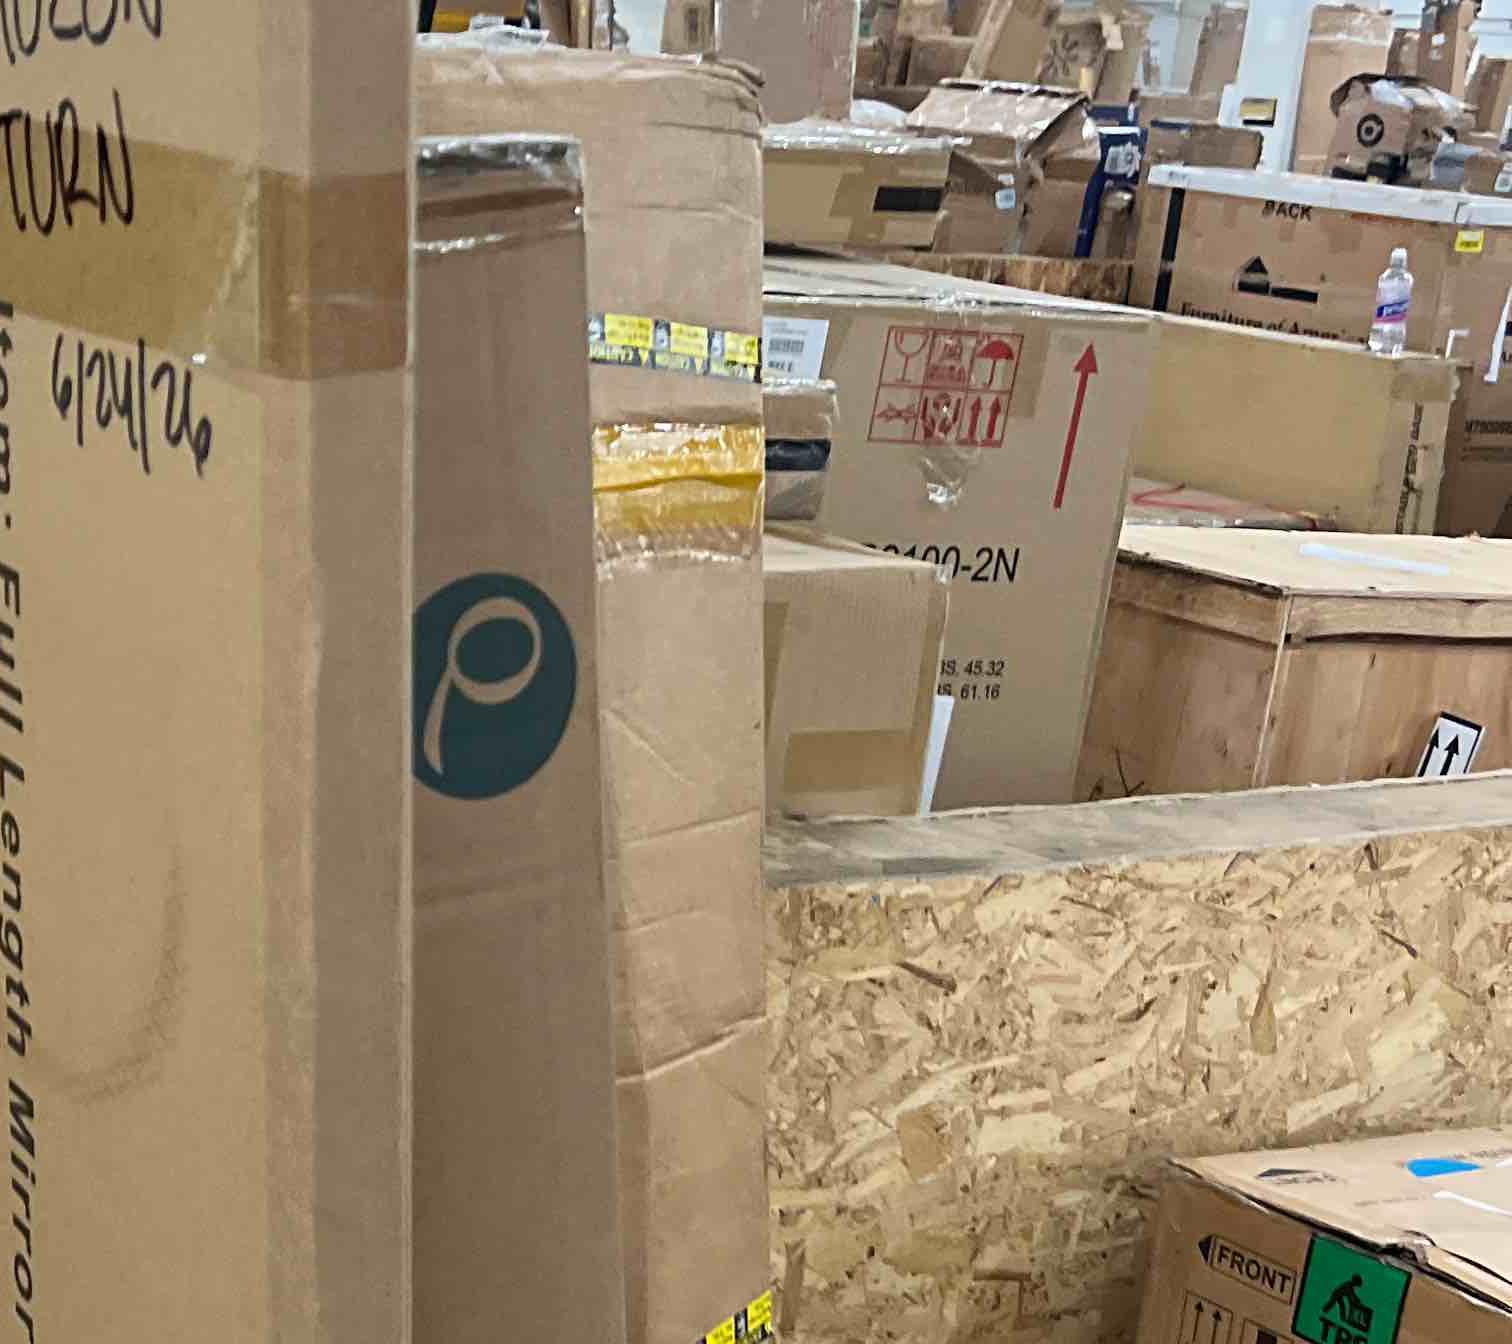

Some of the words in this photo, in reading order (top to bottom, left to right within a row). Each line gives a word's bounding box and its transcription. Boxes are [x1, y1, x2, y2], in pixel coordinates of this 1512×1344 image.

[963, 659, 1005, 677] 45.32
[959, 683, 1001, 700] 61.16
[1217, 1244, 1292, 1295] FRONT
